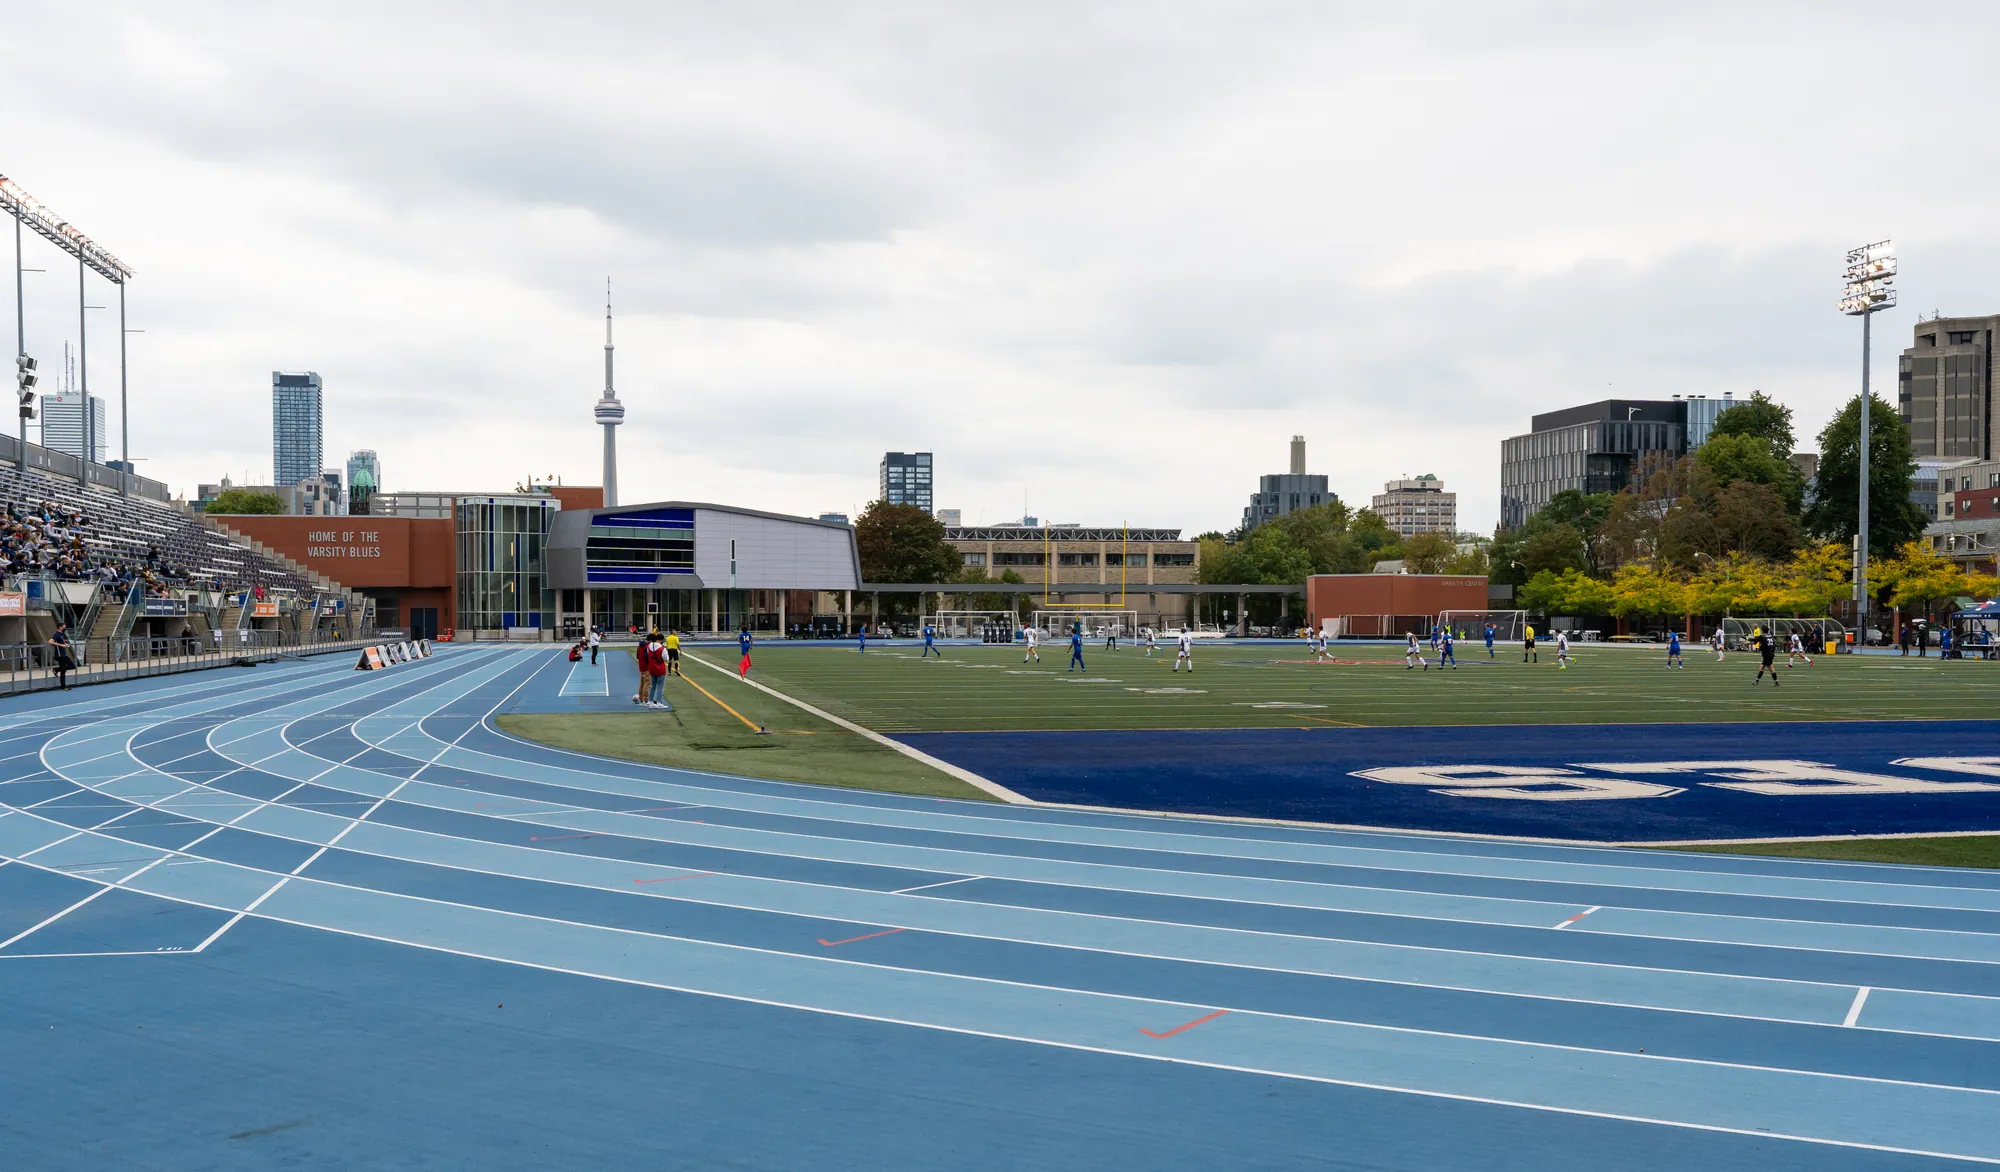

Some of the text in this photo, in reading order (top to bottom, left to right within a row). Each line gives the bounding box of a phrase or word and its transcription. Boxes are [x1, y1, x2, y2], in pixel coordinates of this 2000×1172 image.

[308, 531, 379, 542] HOME OF THE
[307, 546, 381, 557] VARSITY BLUES
